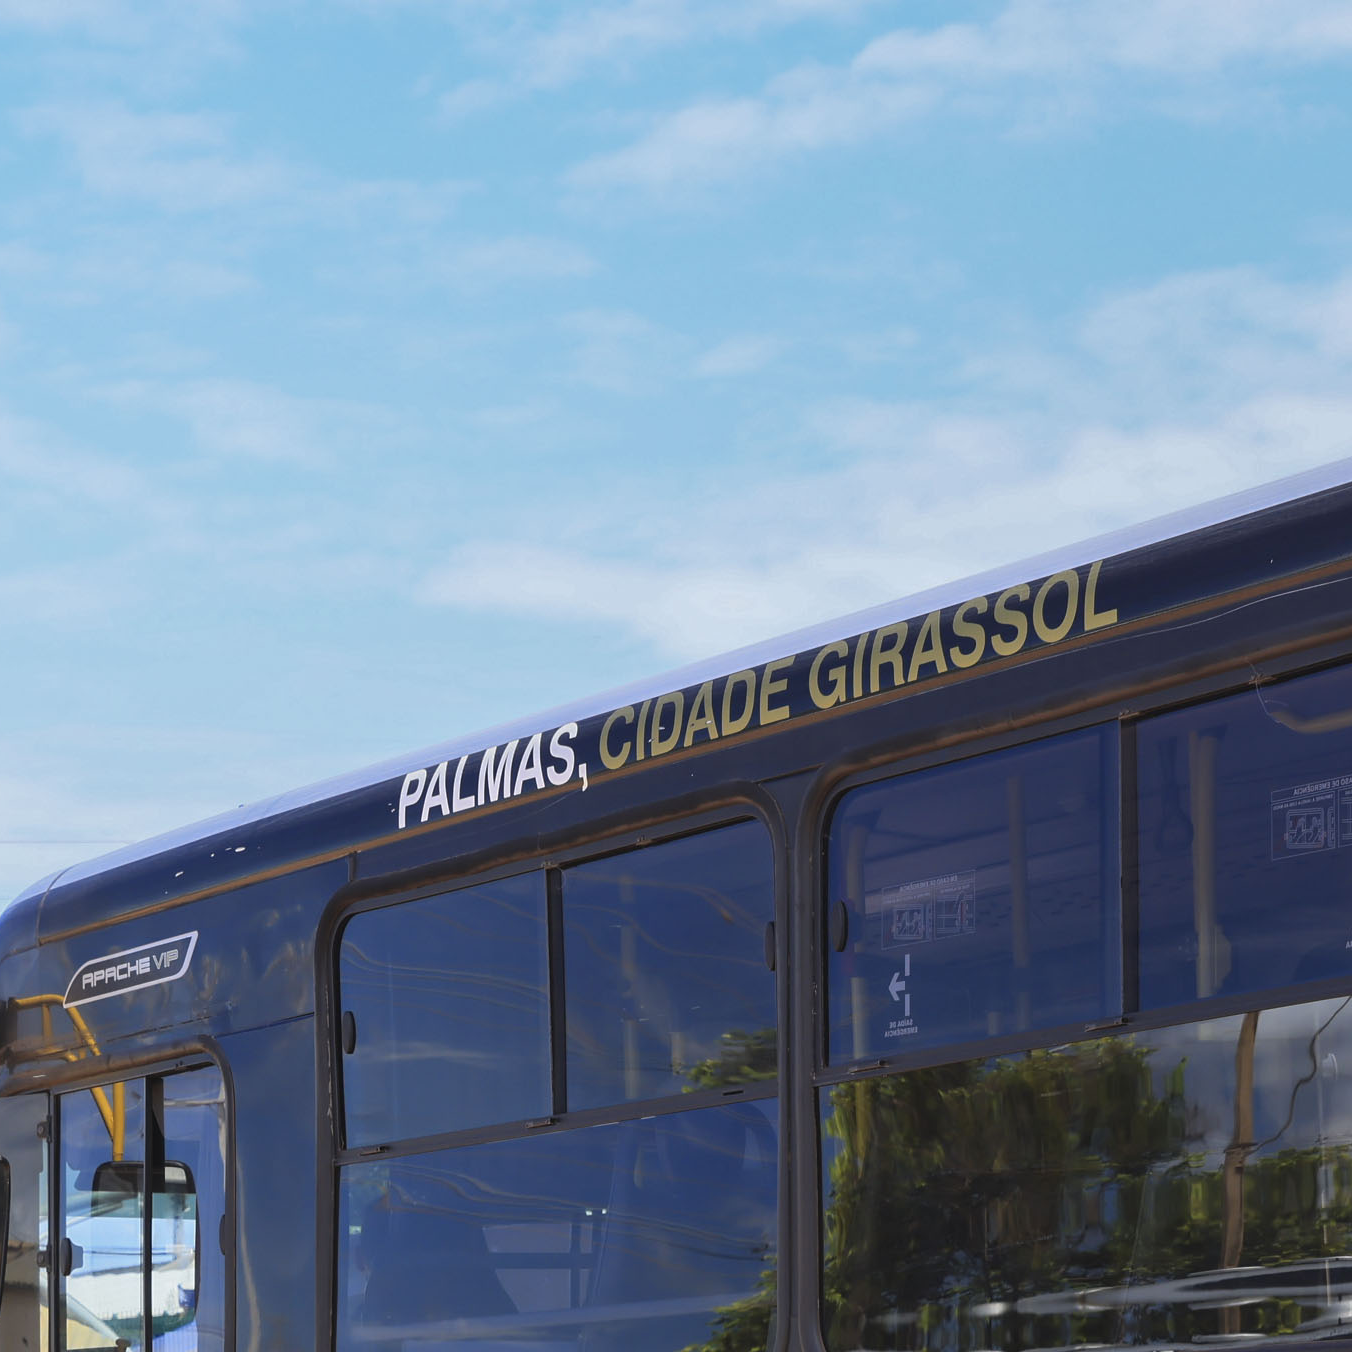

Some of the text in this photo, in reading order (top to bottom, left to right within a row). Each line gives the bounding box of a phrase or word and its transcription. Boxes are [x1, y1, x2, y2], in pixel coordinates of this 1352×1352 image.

[398, 561, 1118, 829] PALMAS, CIDADE GIRASSOL
[82, 948, 179, 990] APACHE VIP
